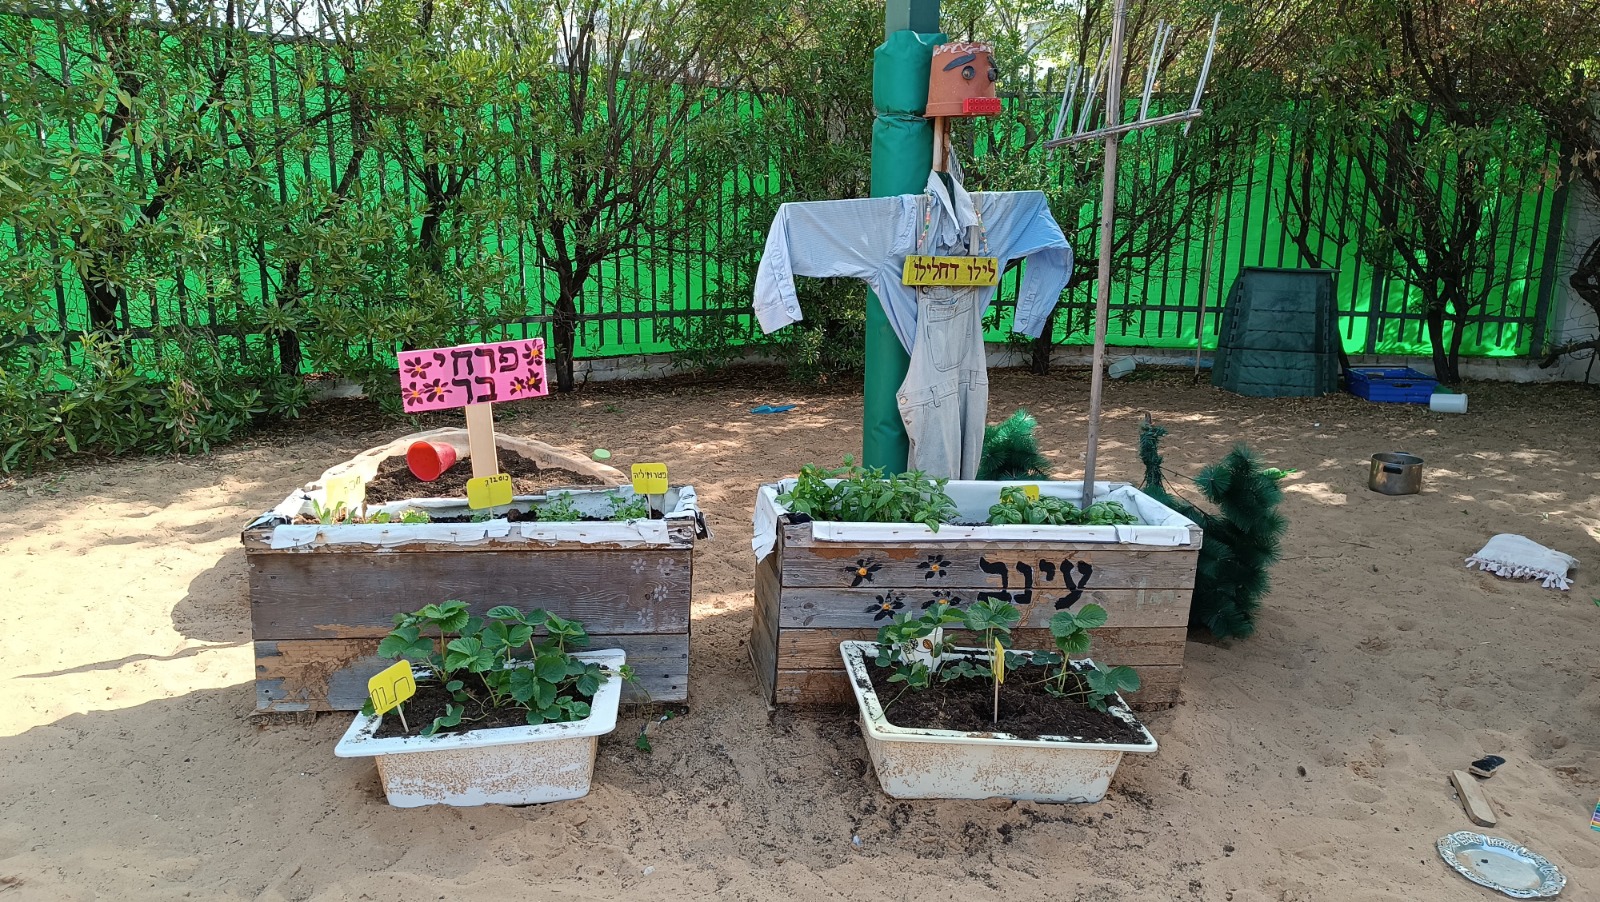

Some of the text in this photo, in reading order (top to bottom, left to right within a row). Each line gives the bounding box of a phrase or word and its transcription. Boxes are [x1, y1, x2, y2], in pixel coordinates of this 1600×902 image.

[914, 257, 996, 282] לילו דחלילו
[433, 345, 519, 376] פרחי
[452, 376, 497, 404] בר
[977, 557, 1093, 610] עינב
[370, 676, 411, 711] תות
